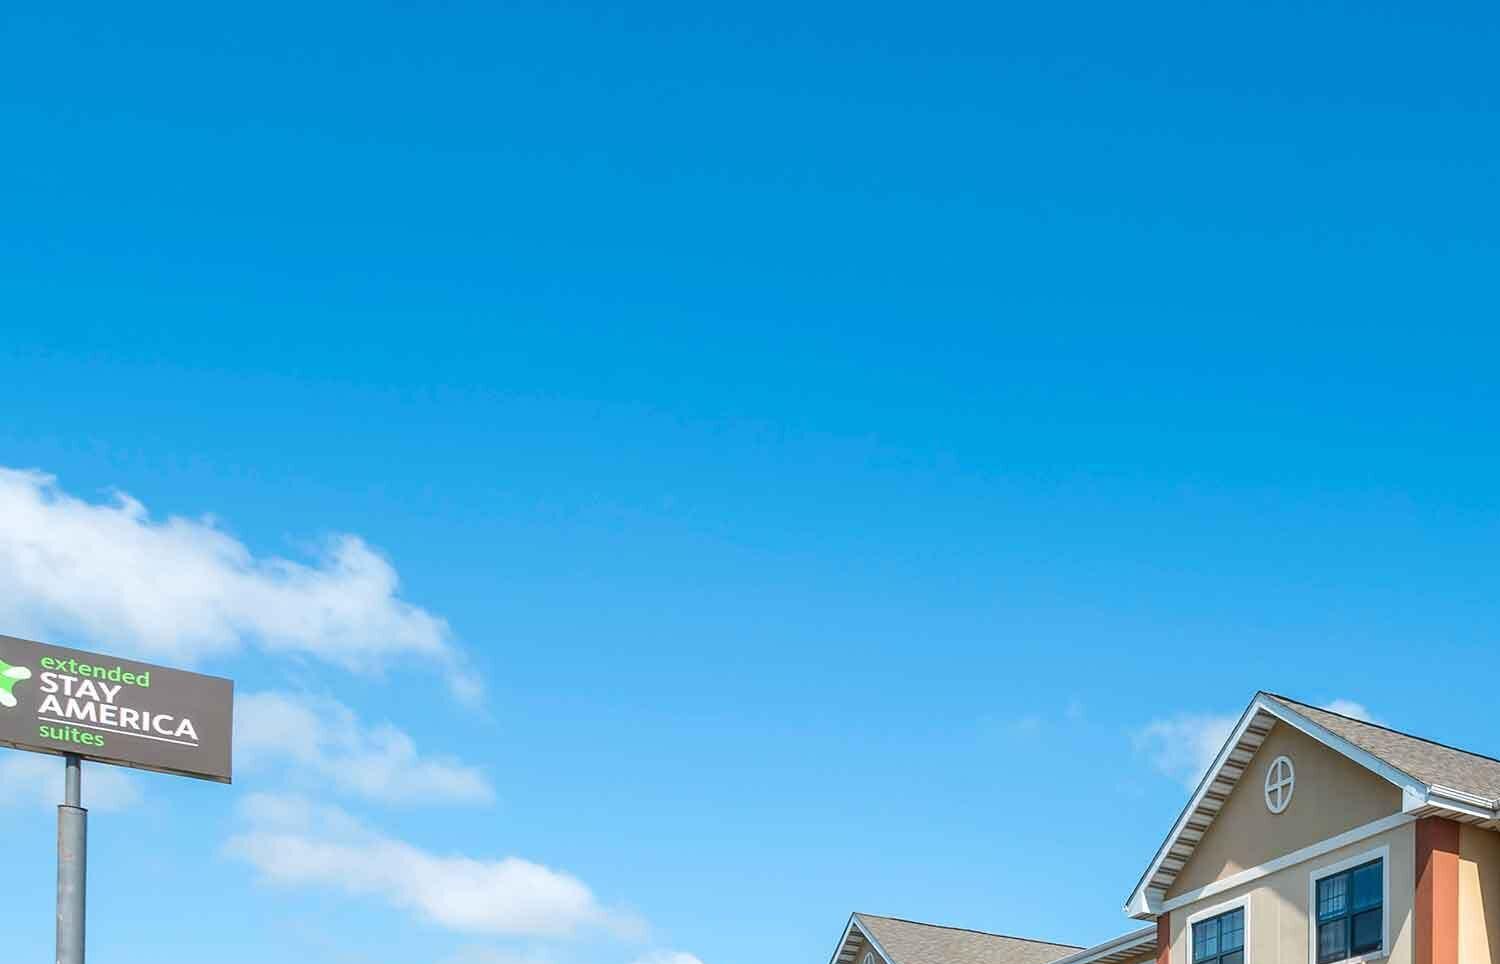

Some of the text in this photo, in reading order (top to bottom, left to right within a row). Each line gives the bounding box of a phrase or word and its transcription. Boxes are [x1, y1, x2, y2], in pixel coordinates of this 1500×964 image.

[40, 656, 150, 688] extended
[40, 671, 122, 704] STAY
[38, 694, 199, 740] AMERICA
[39, 725, 105, 747] suites
